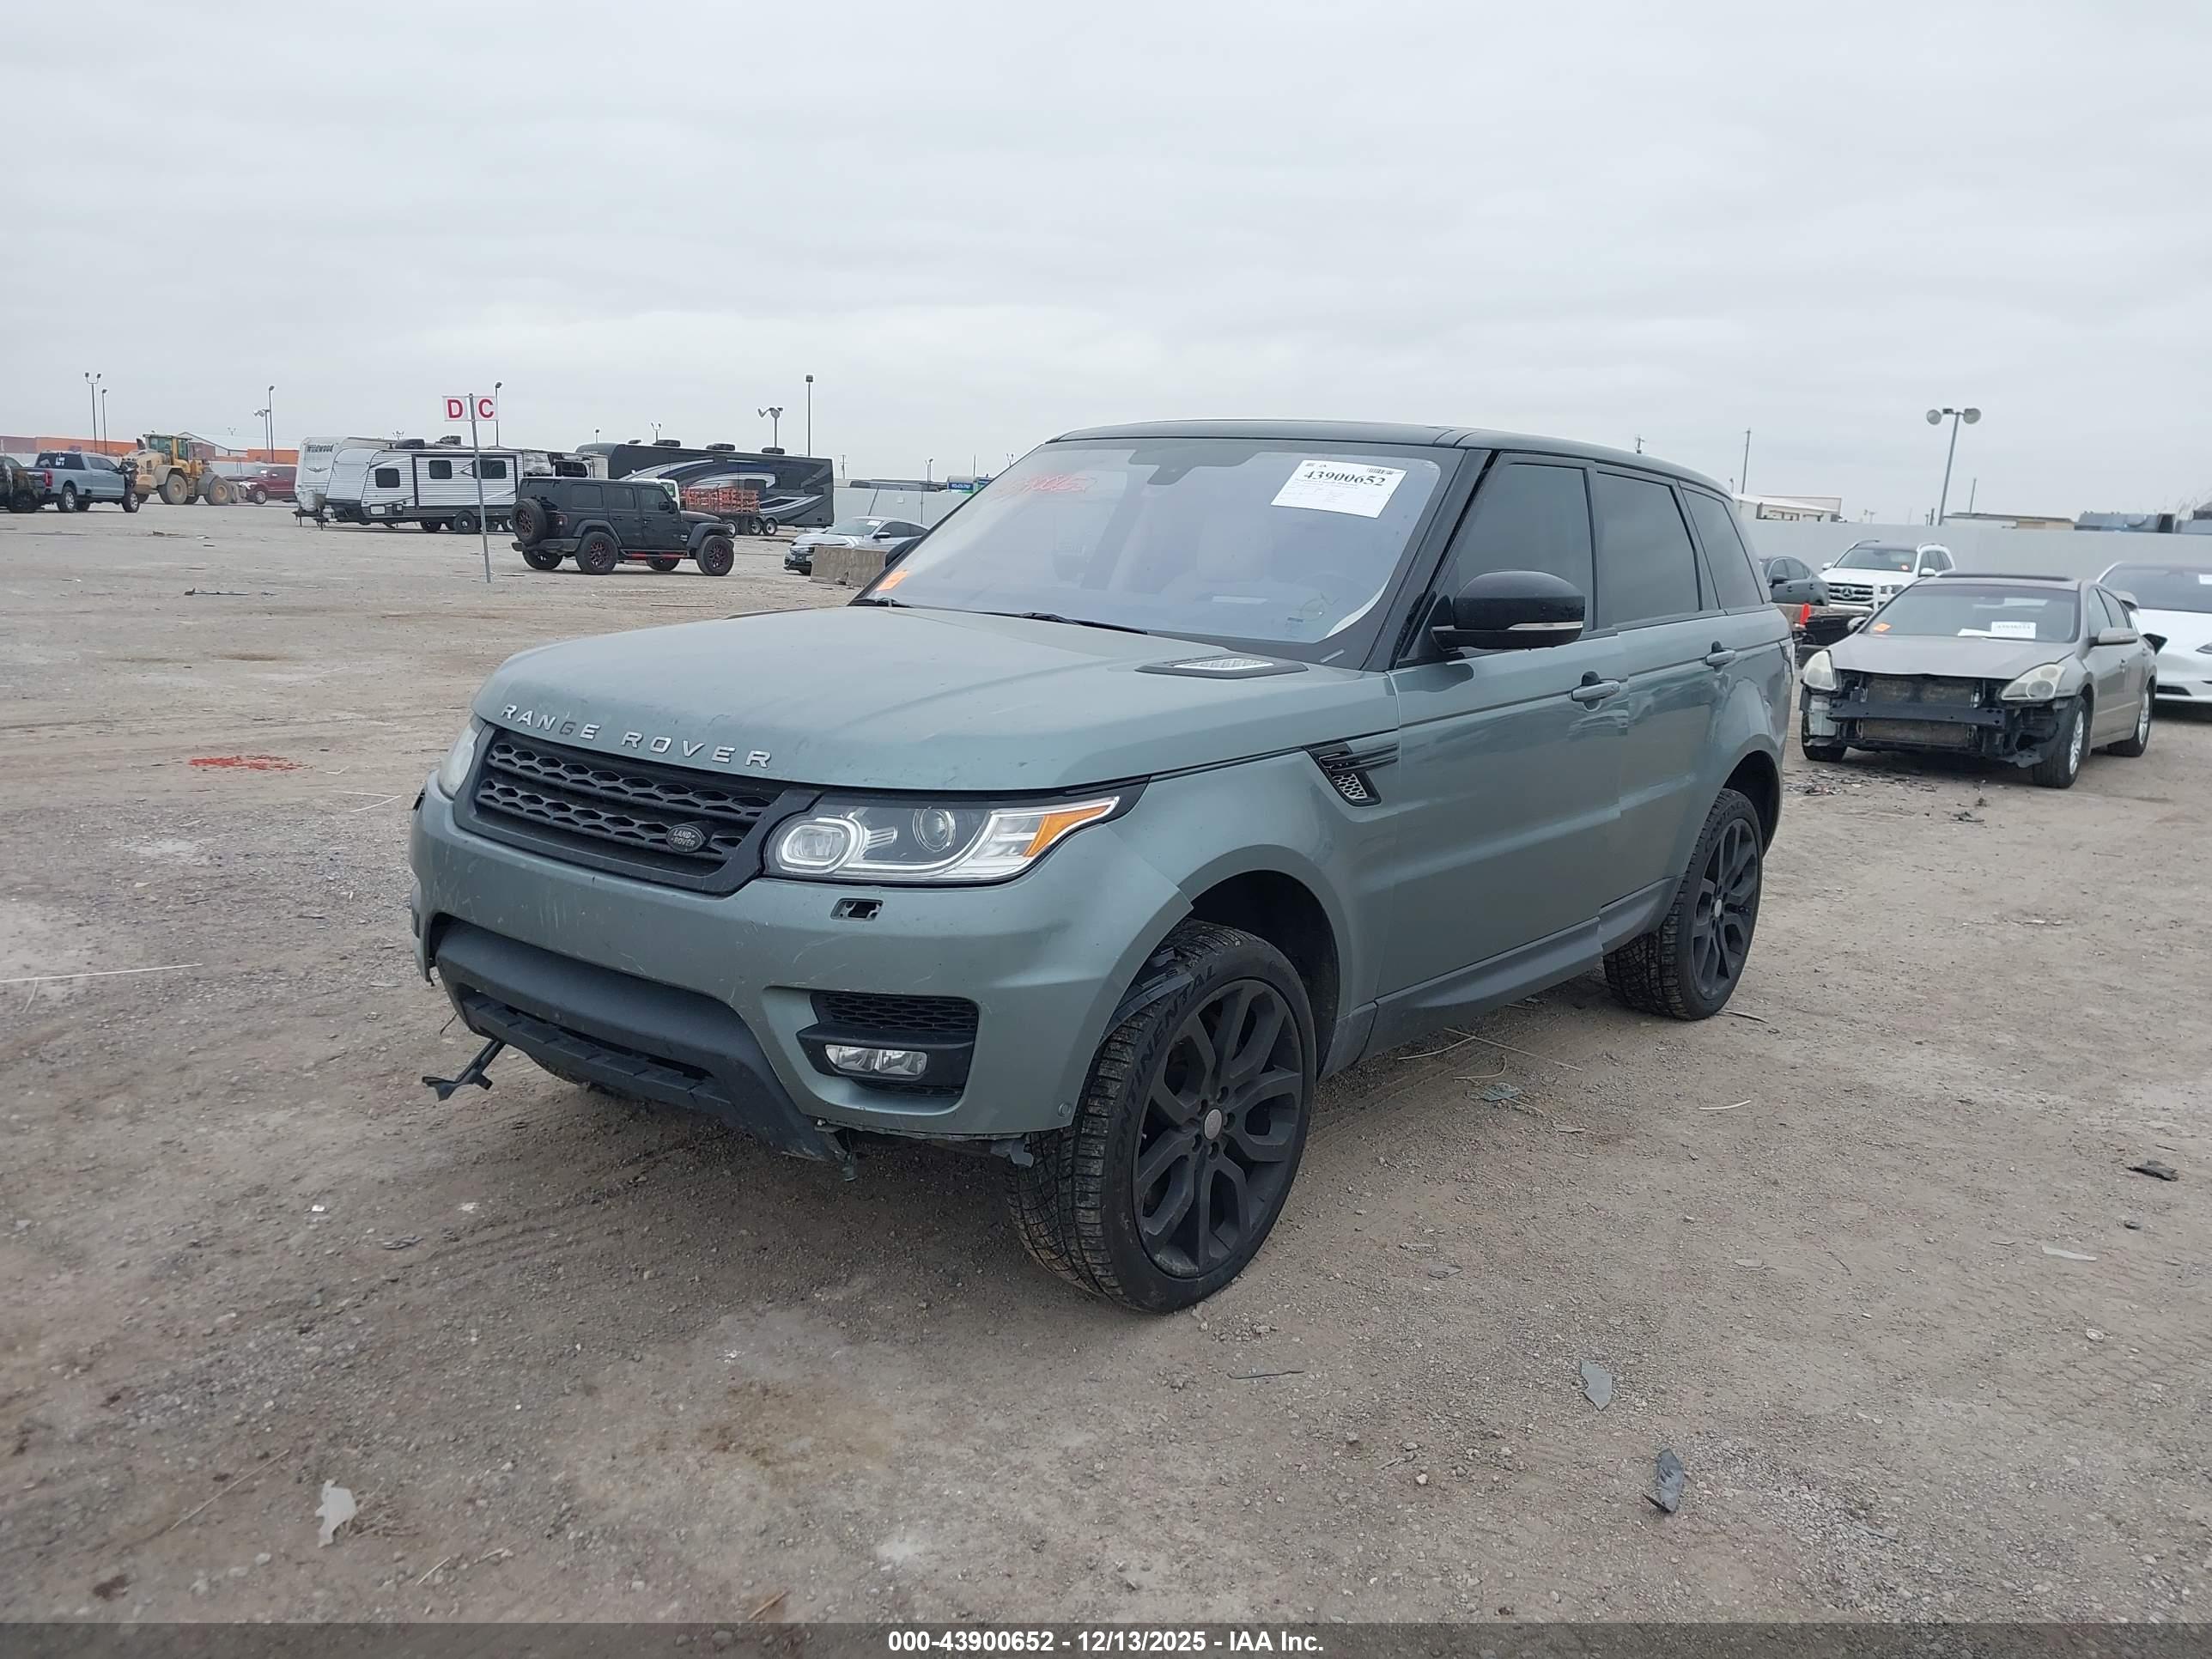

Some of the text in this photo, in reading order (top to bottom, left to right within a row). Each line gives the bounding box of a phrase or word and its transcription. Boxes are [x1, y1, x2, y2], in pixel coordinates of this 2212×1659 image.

[447, 398, 464, 418] D
[478, 398, 495, 418] C
[1304, 470, 1386, 487] 43900652
[501, 703, 771, 768] RANGE ROVER
